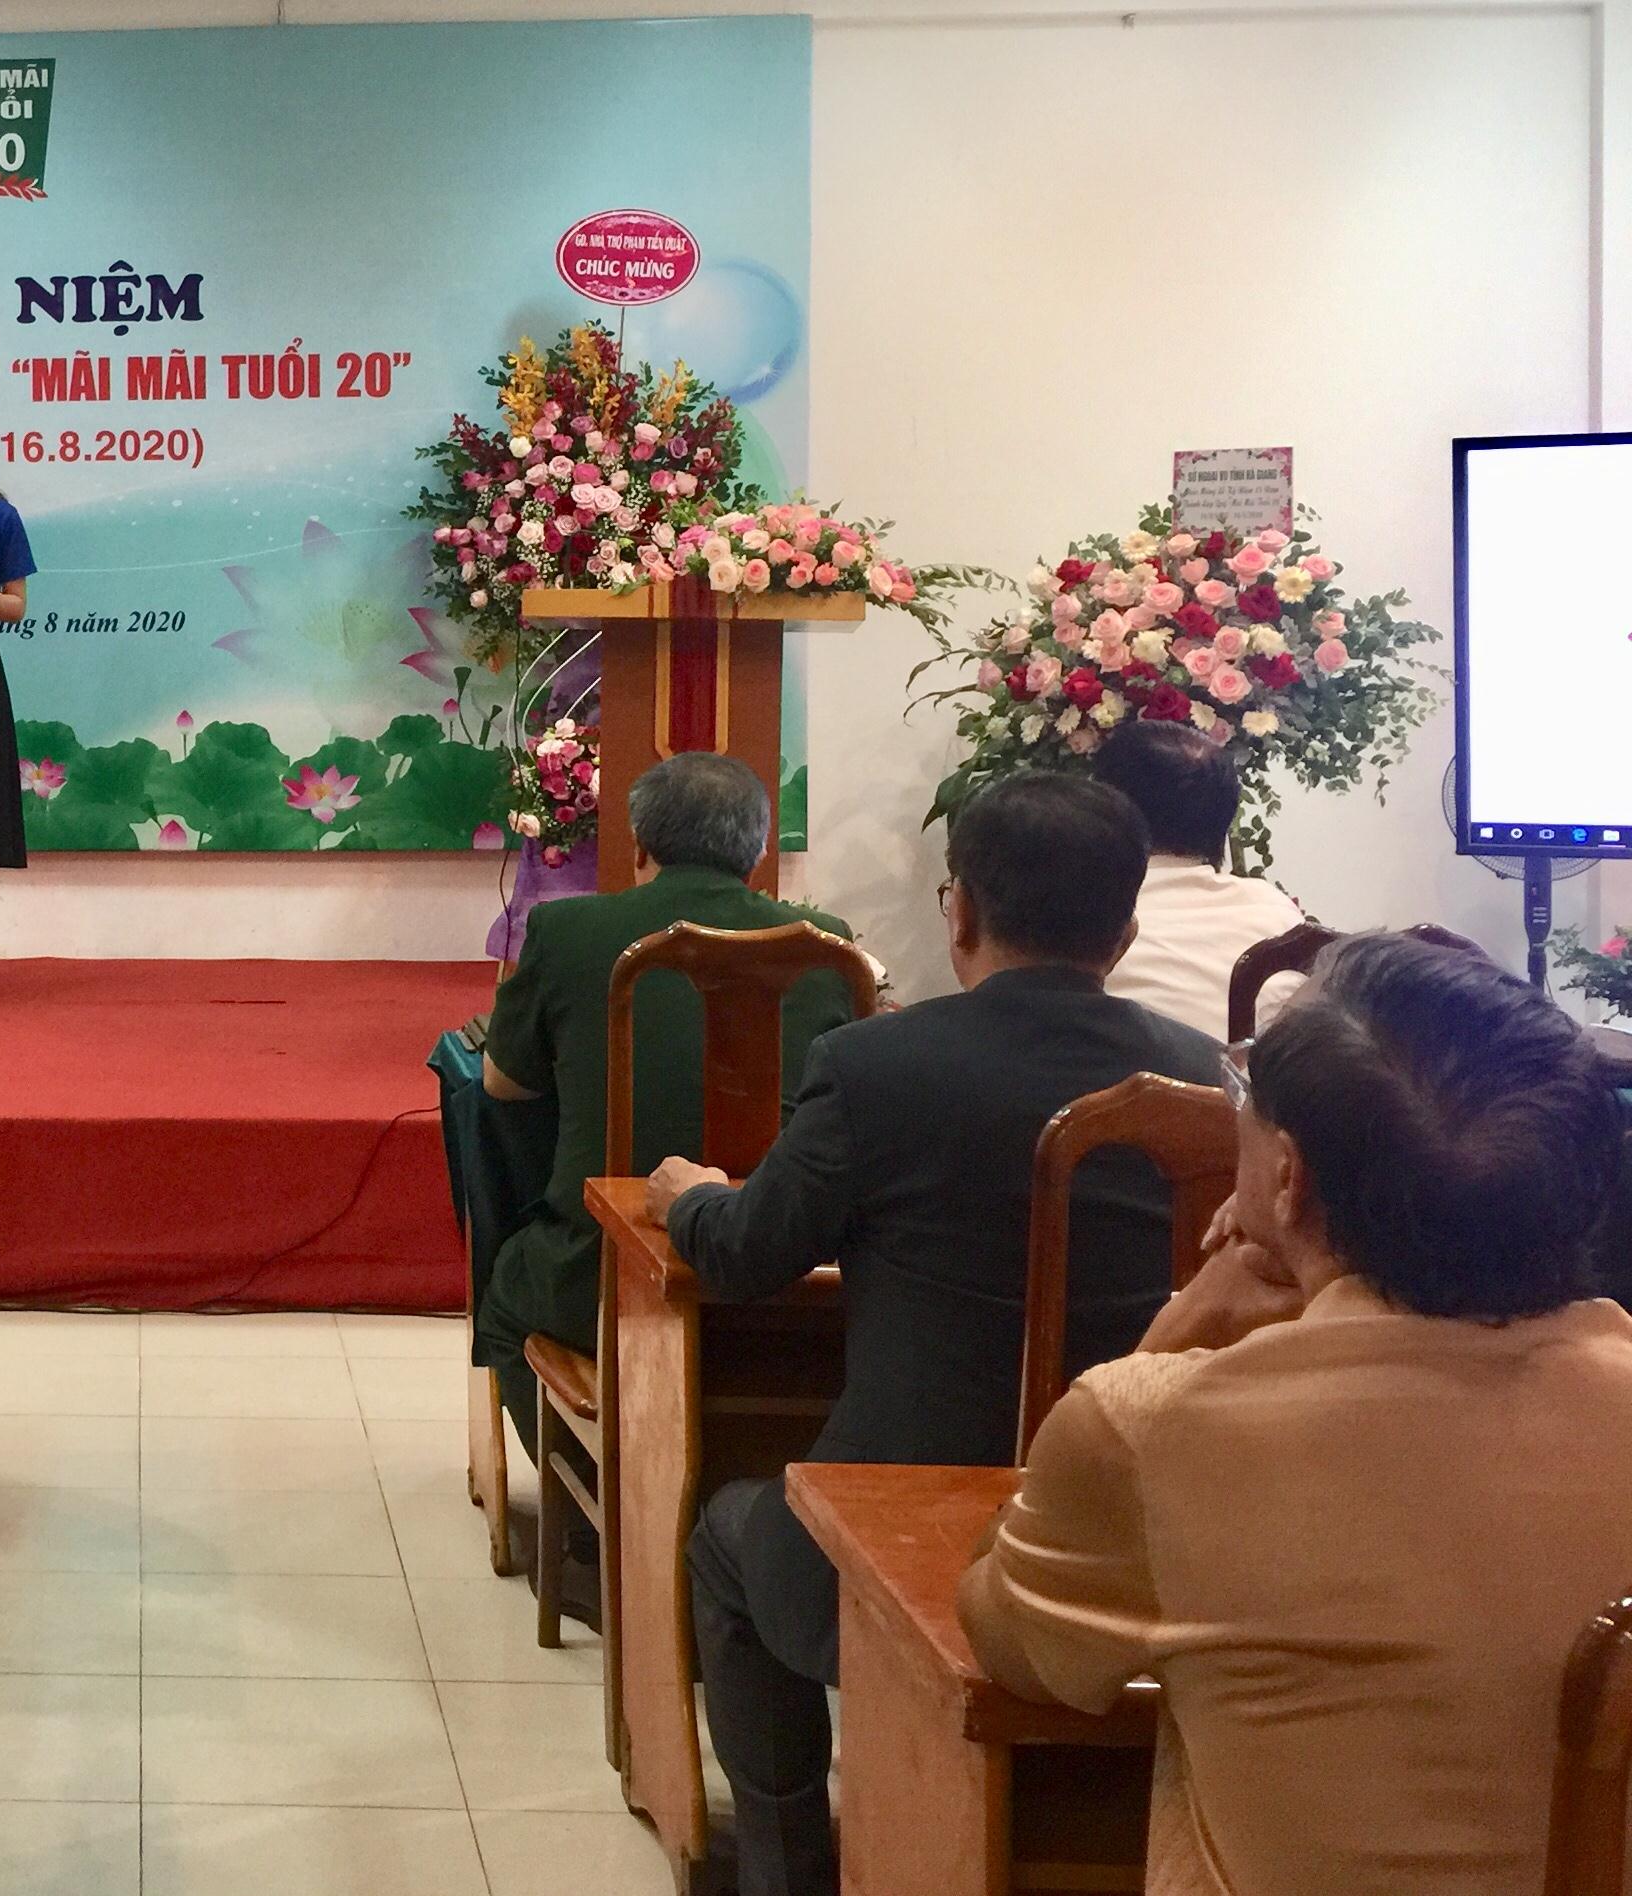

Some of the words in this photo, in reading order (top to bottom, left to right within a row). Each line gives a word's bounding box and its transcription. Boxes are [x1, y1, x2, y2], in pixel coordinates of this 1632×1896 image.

[0, 63, 49, 89] MÃI
[575, 255, 621, 277] CHÚC
[624, 256, 675, 279] MỪNG
[14, 259, 205, 336] NIỆM
[11, 350, 111, 402] “MÃI
[127, 348, 207, 401] MÃI
[221, 337, 321, 400] TUỔI
[336, 351, 412, 399] 20”
[0, 428, 204, 468] 16.8.2020)
[44, 611, 59, 634] 8
[65, 611, 119, 634] năm
[126, 610, 186, 634] 2020
